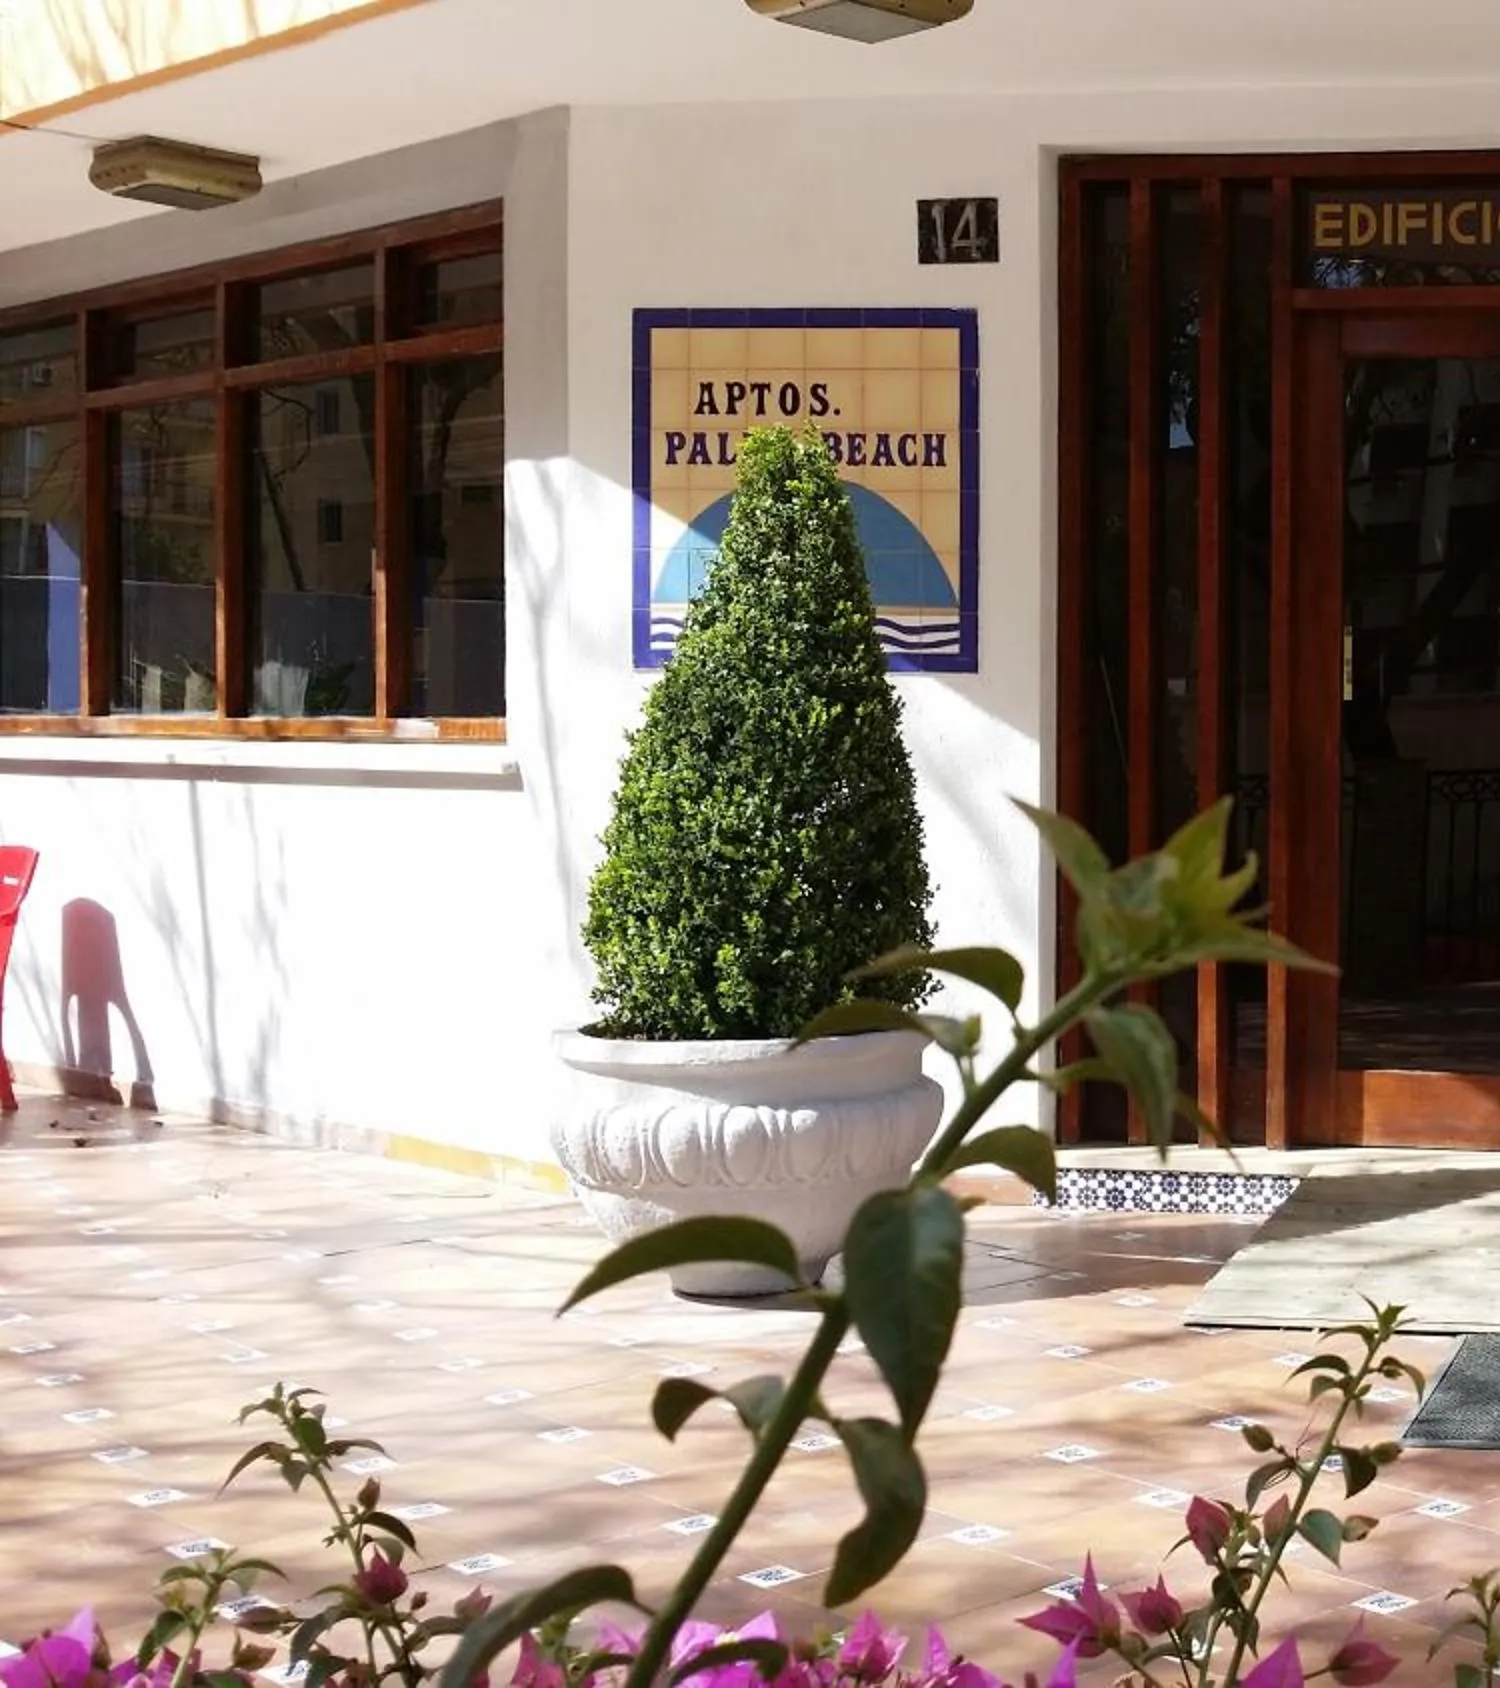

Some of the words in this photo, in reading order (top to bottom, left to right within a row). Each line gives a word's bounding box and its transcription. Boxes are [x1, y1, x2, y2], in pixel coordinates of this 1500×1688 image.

[931, 201, 982, 262] 14
[694, 381, 841, 416] APTOS.
[665, 431, 755, 466] PAL
[821, 432, 947, 467] BEACH
